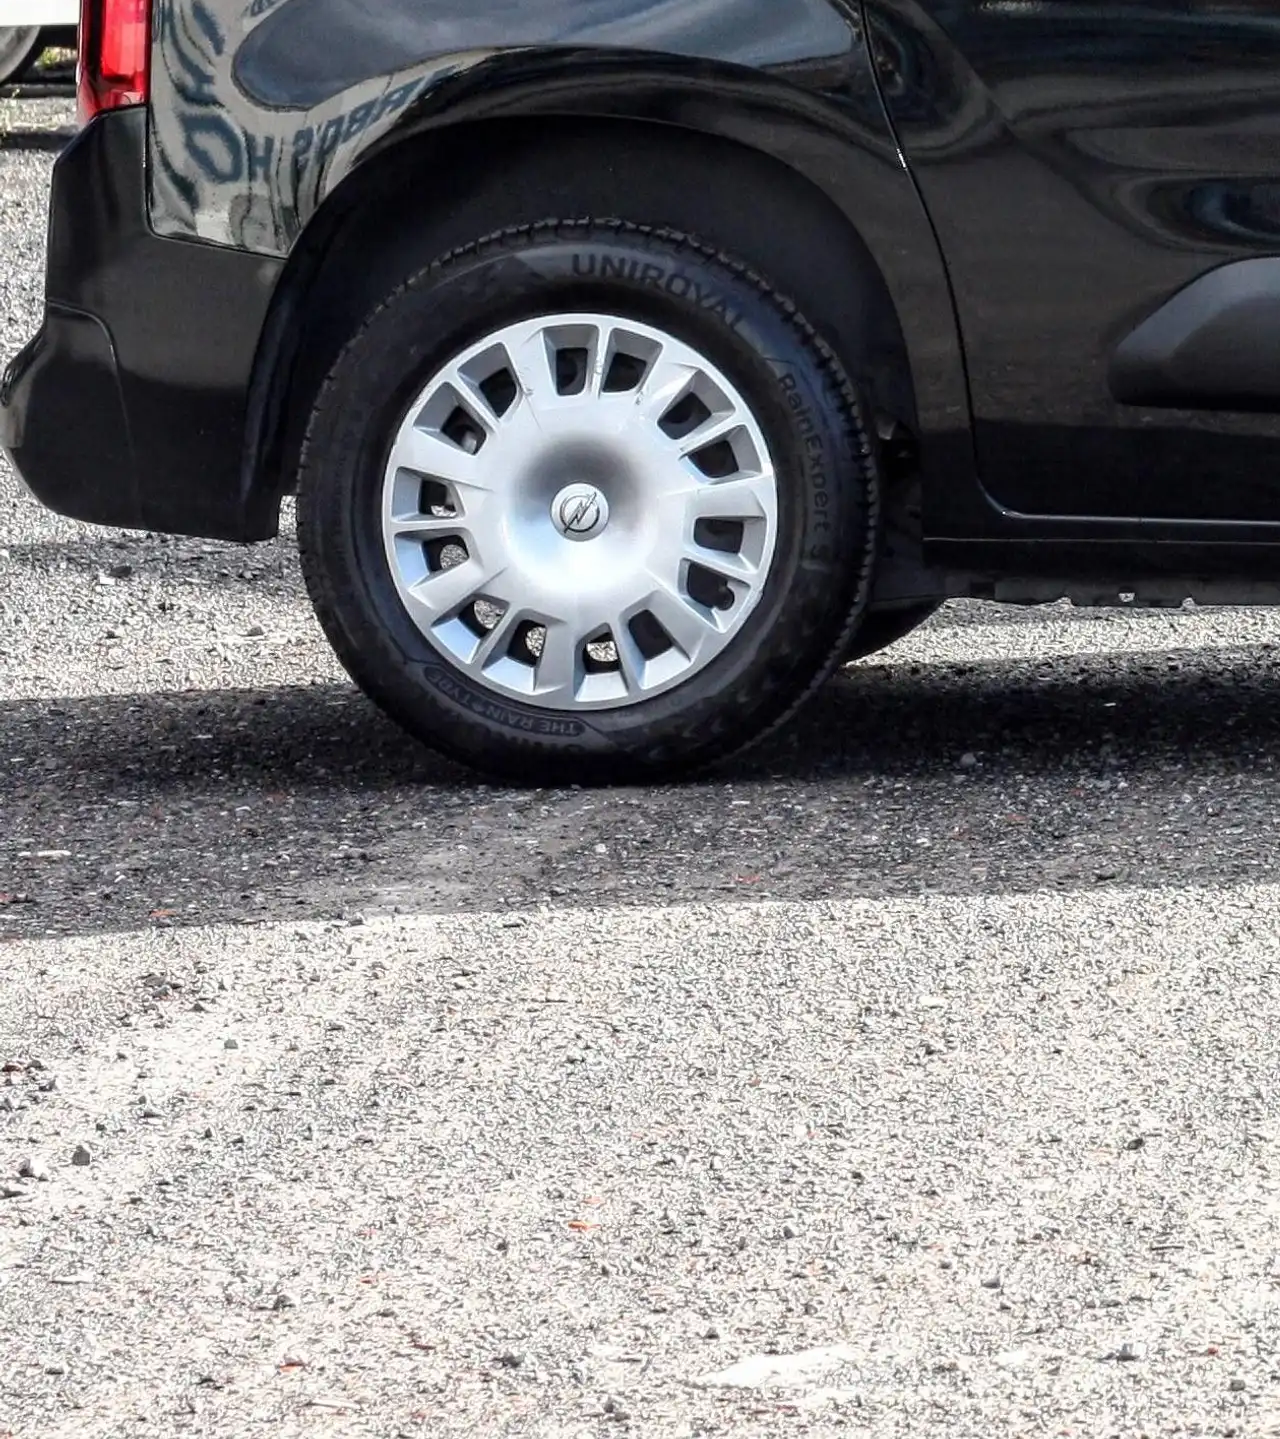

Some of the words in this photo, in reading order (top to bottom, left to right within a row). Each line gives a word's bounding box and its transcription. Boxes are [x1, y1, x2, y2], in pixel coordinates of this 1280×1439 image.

[572, 254, 746, 332] UNIROYAL
[778, 372, 831, 533] RainExpert
[484, 705, 533, 730] RAIN
